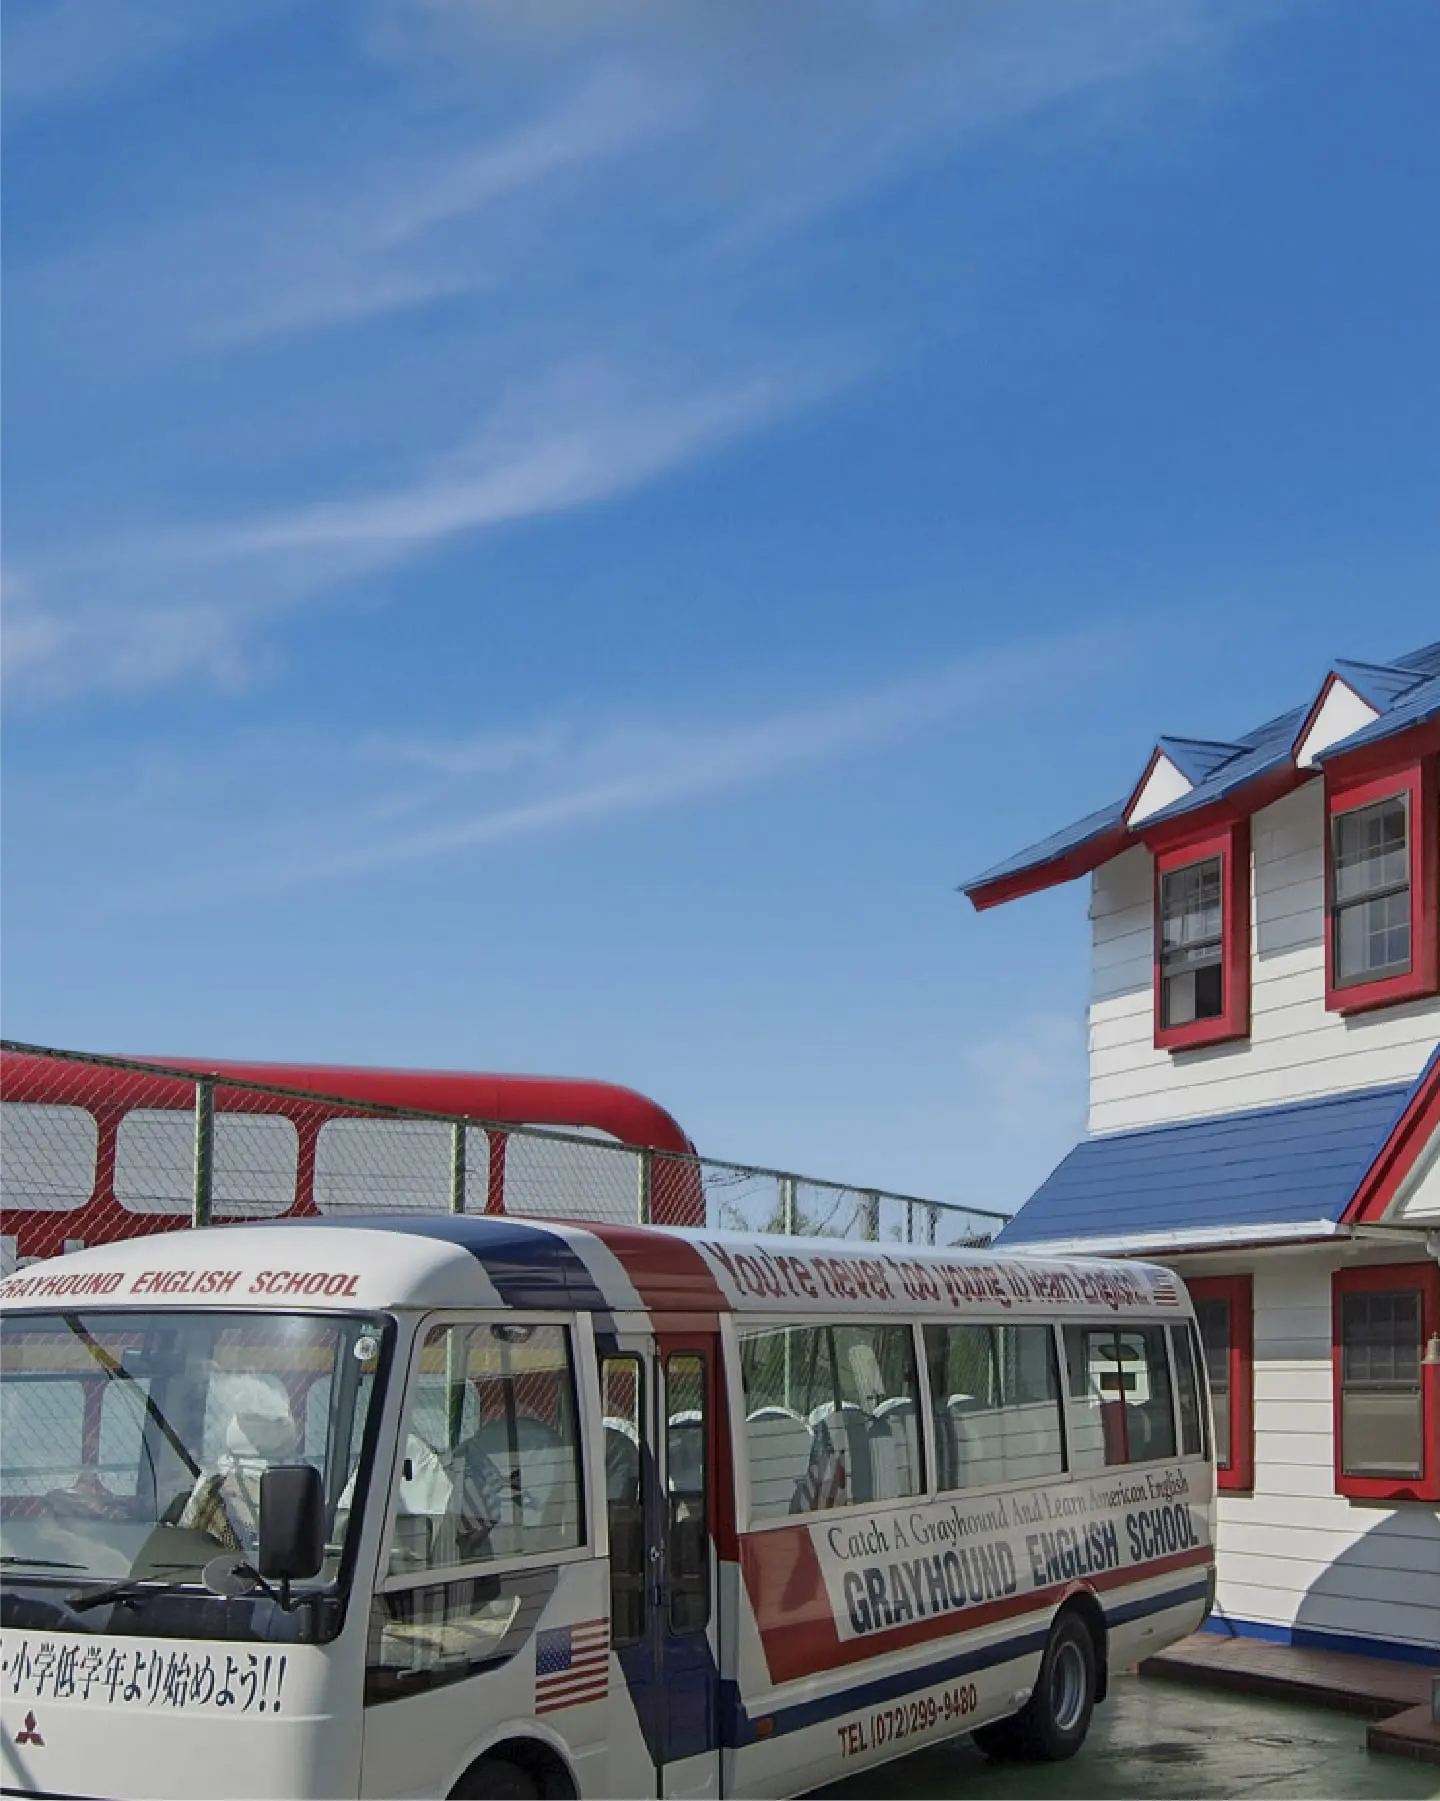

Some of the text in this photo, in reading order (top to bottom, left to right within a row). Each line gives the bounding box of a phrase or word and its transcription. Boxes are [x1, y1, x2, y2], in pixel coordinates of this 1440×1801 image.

[130, 1270, 243, 1294] ENGLISH
[248, 1270, 361, 1297] SCHOOL
[699, 1240, 818, 1299] You're
[810, 1257, 896, 1300] never
[881, 1253, 941, 1301] too
[931, 1264, 1012, 1308] young
[994, 1260, 1031, 1303] to
[1013, 1260, 1084, 1304] learn
[827, 1467, 1191, 1561] Catch A Grayhound And Learn American English
[843, 1501, 1201, 1634] GRAYHOUND ENGLISH SCHOOL
